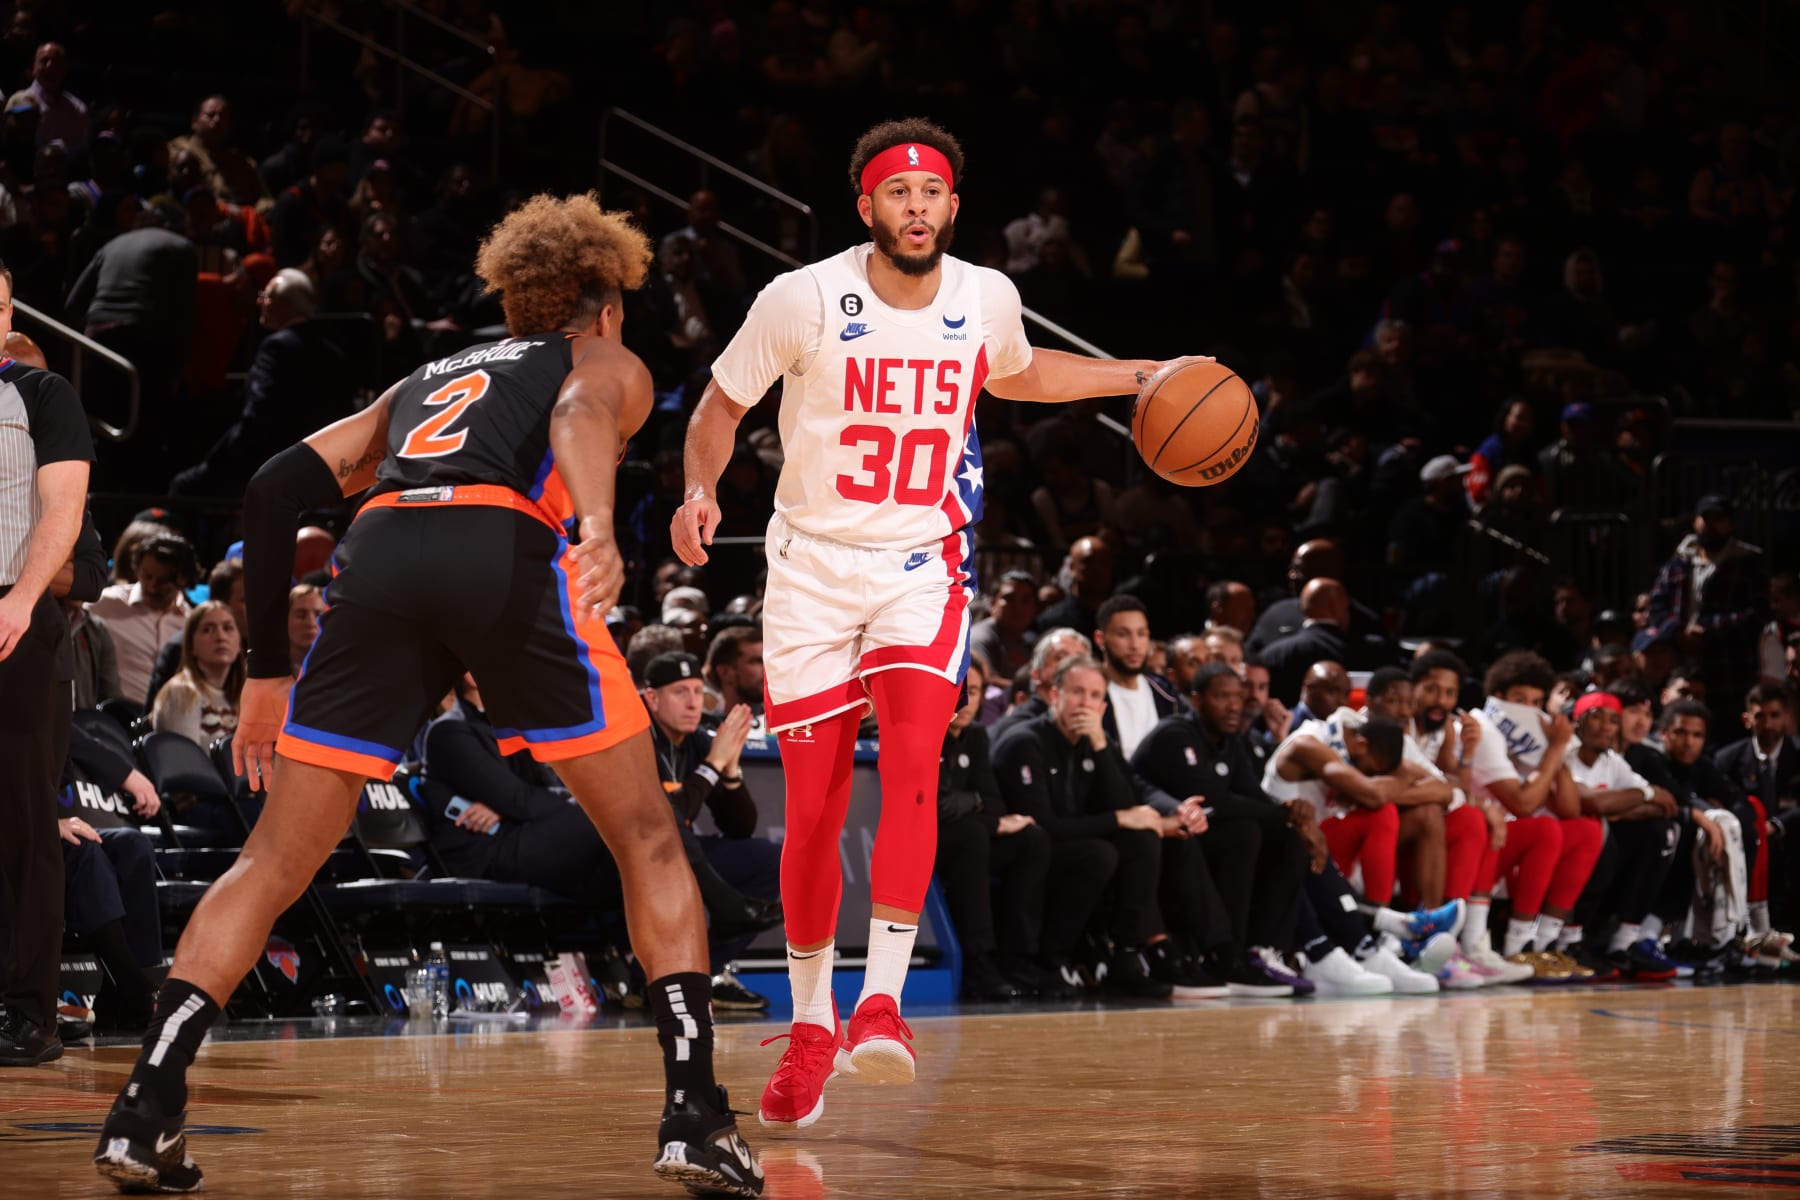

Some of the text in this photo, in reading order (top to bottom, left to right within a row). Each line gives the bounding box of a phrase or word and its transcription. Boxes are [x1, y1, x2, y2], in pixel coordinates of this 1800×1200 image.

[845, 296, 858, 314] 6
[846, 322, 868, 334] NIKE
[942, 333, 967, 341] Webull
[844, 356, 962, 415] NETS
[396, 368, 491, 459] 2
[835, 424, 951, 507] 30
[1197, 417, 1260, 481] Wilson
[910, 552, 929, 563] NIKE
